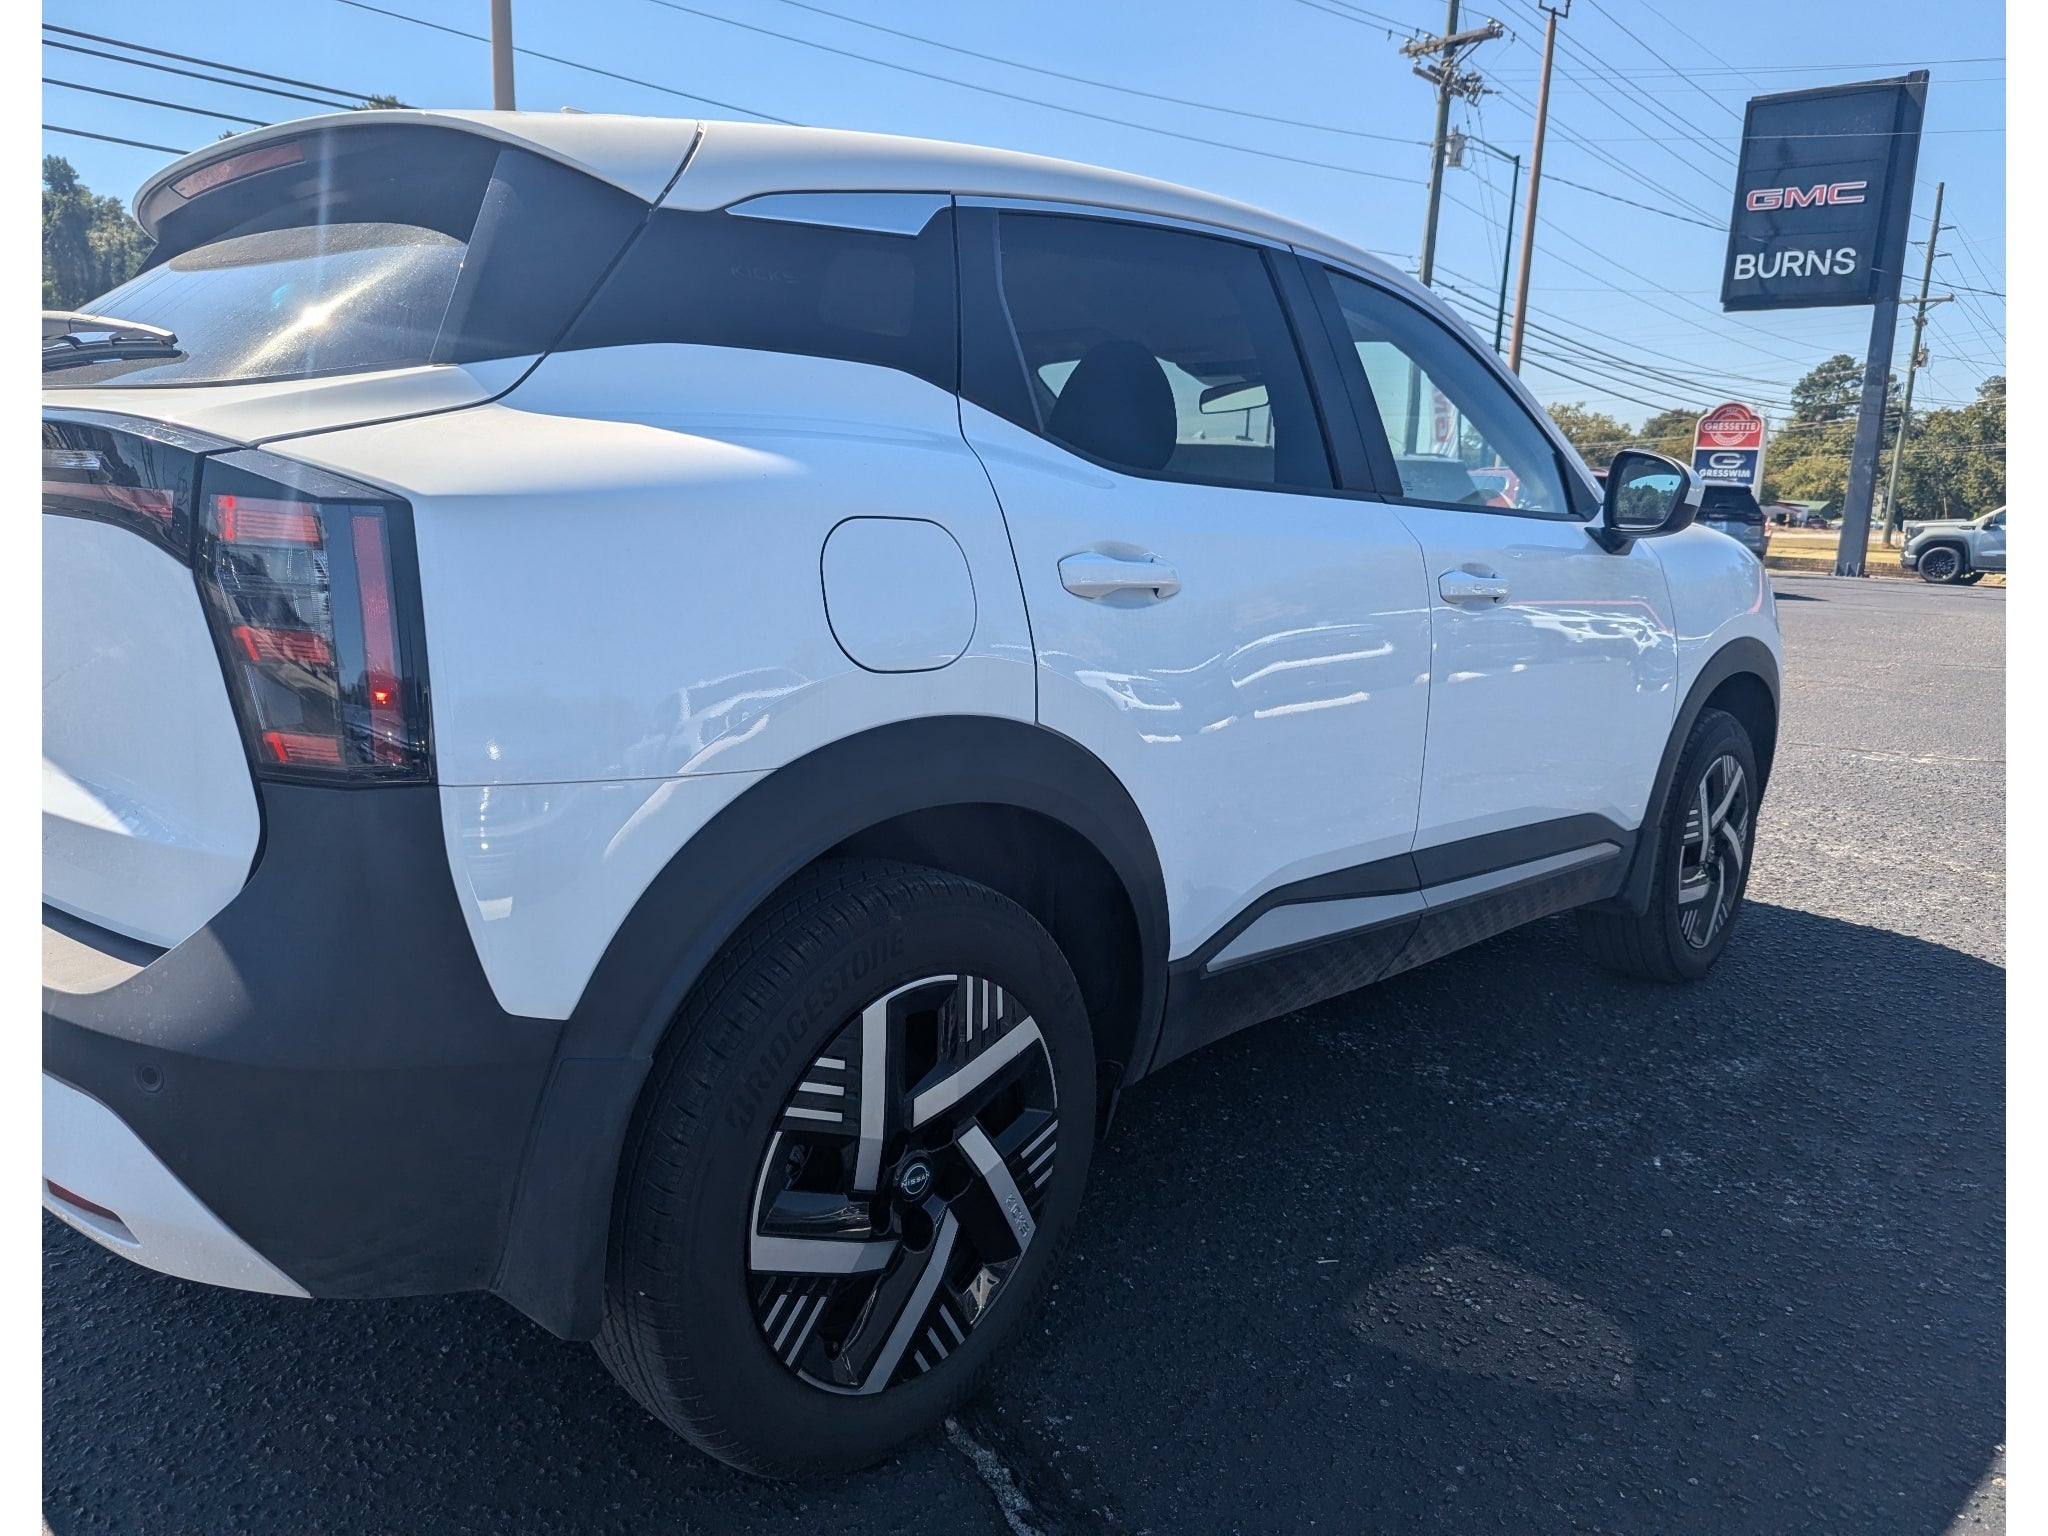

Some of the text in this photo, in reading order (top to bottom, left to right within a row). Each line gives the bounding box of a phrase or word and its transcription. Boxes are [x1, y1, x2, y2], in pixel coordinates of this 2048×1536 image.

[1746, 181, 1867, 211] GMC
[730, 265, 800, 284] KICKS
[1734, 247, 1857, 280] BURNS
[1704, 422, 1756, 431] GRESSETTE
[1698, 469, 1751, 478] GRESSWIM
[726, 932, 904, 1135] BRIDGESTONE
[901, 1171, 930, 1188] NISSAN
[1005, 1192, 1030, 1238] KICKS
